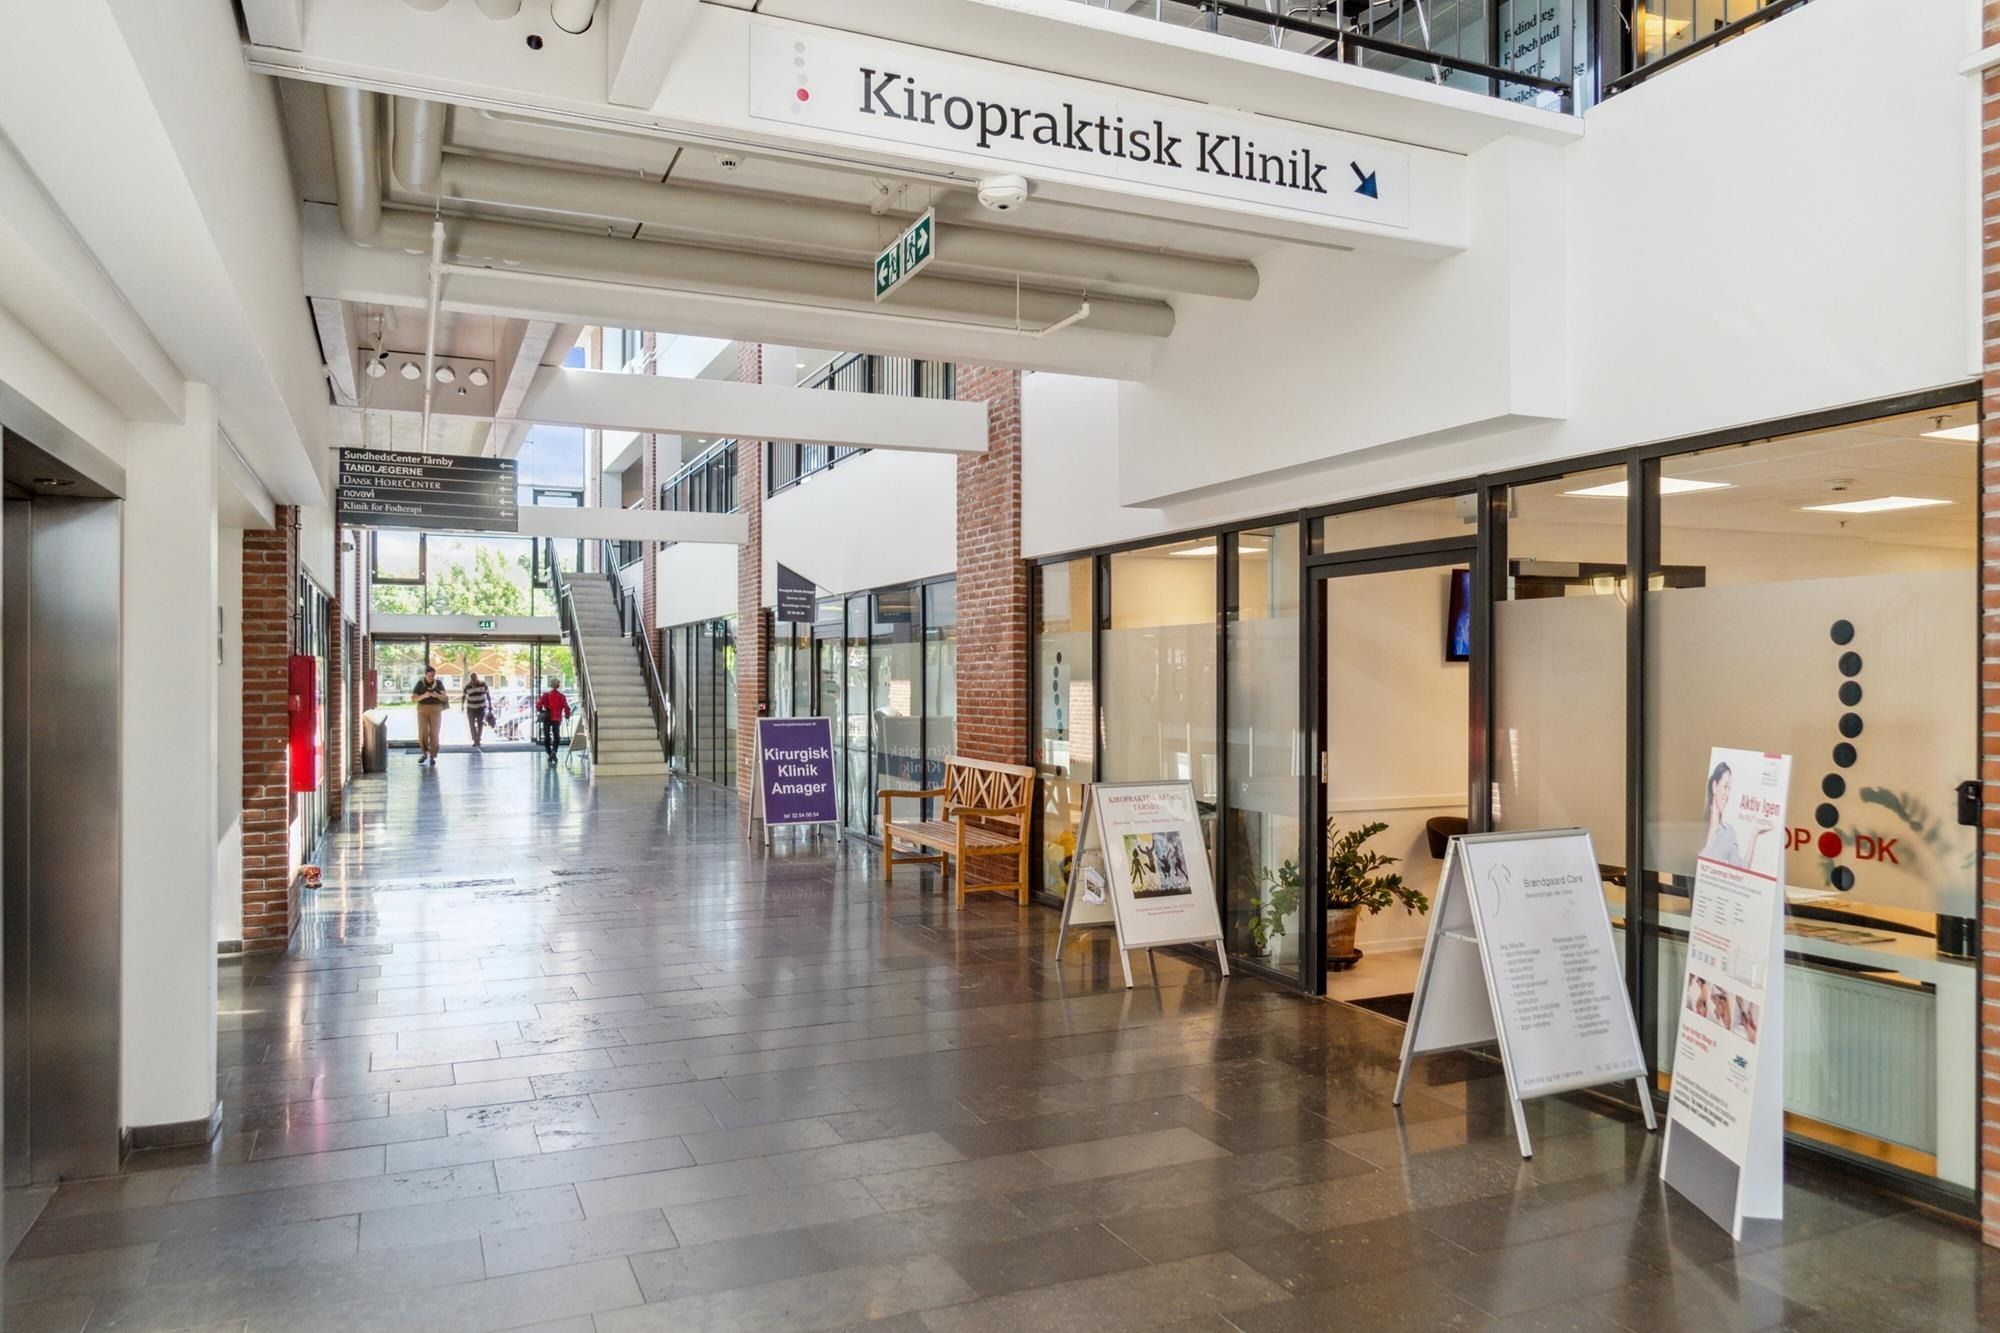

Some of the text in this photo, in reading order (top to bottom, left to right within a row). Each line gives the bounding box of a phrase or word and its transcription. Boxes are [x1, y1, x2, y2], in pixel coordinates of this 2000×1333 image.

[860, 67, 1328, 194] Kiropraktisk Klinik
[344, 450, 453, 468] SundhedsCenter Tårnby
[344, 463, 424, 476] TANDLÆGERNE
[343, 501, 422, 515] Klinik for Fodterapi
[764, 747, 829, 762] Kirurgisk
[778, 764, 819, 777] Klinik
[771, 782, 827, 796] Amager
[1567, 874, 1583, 884] Care
